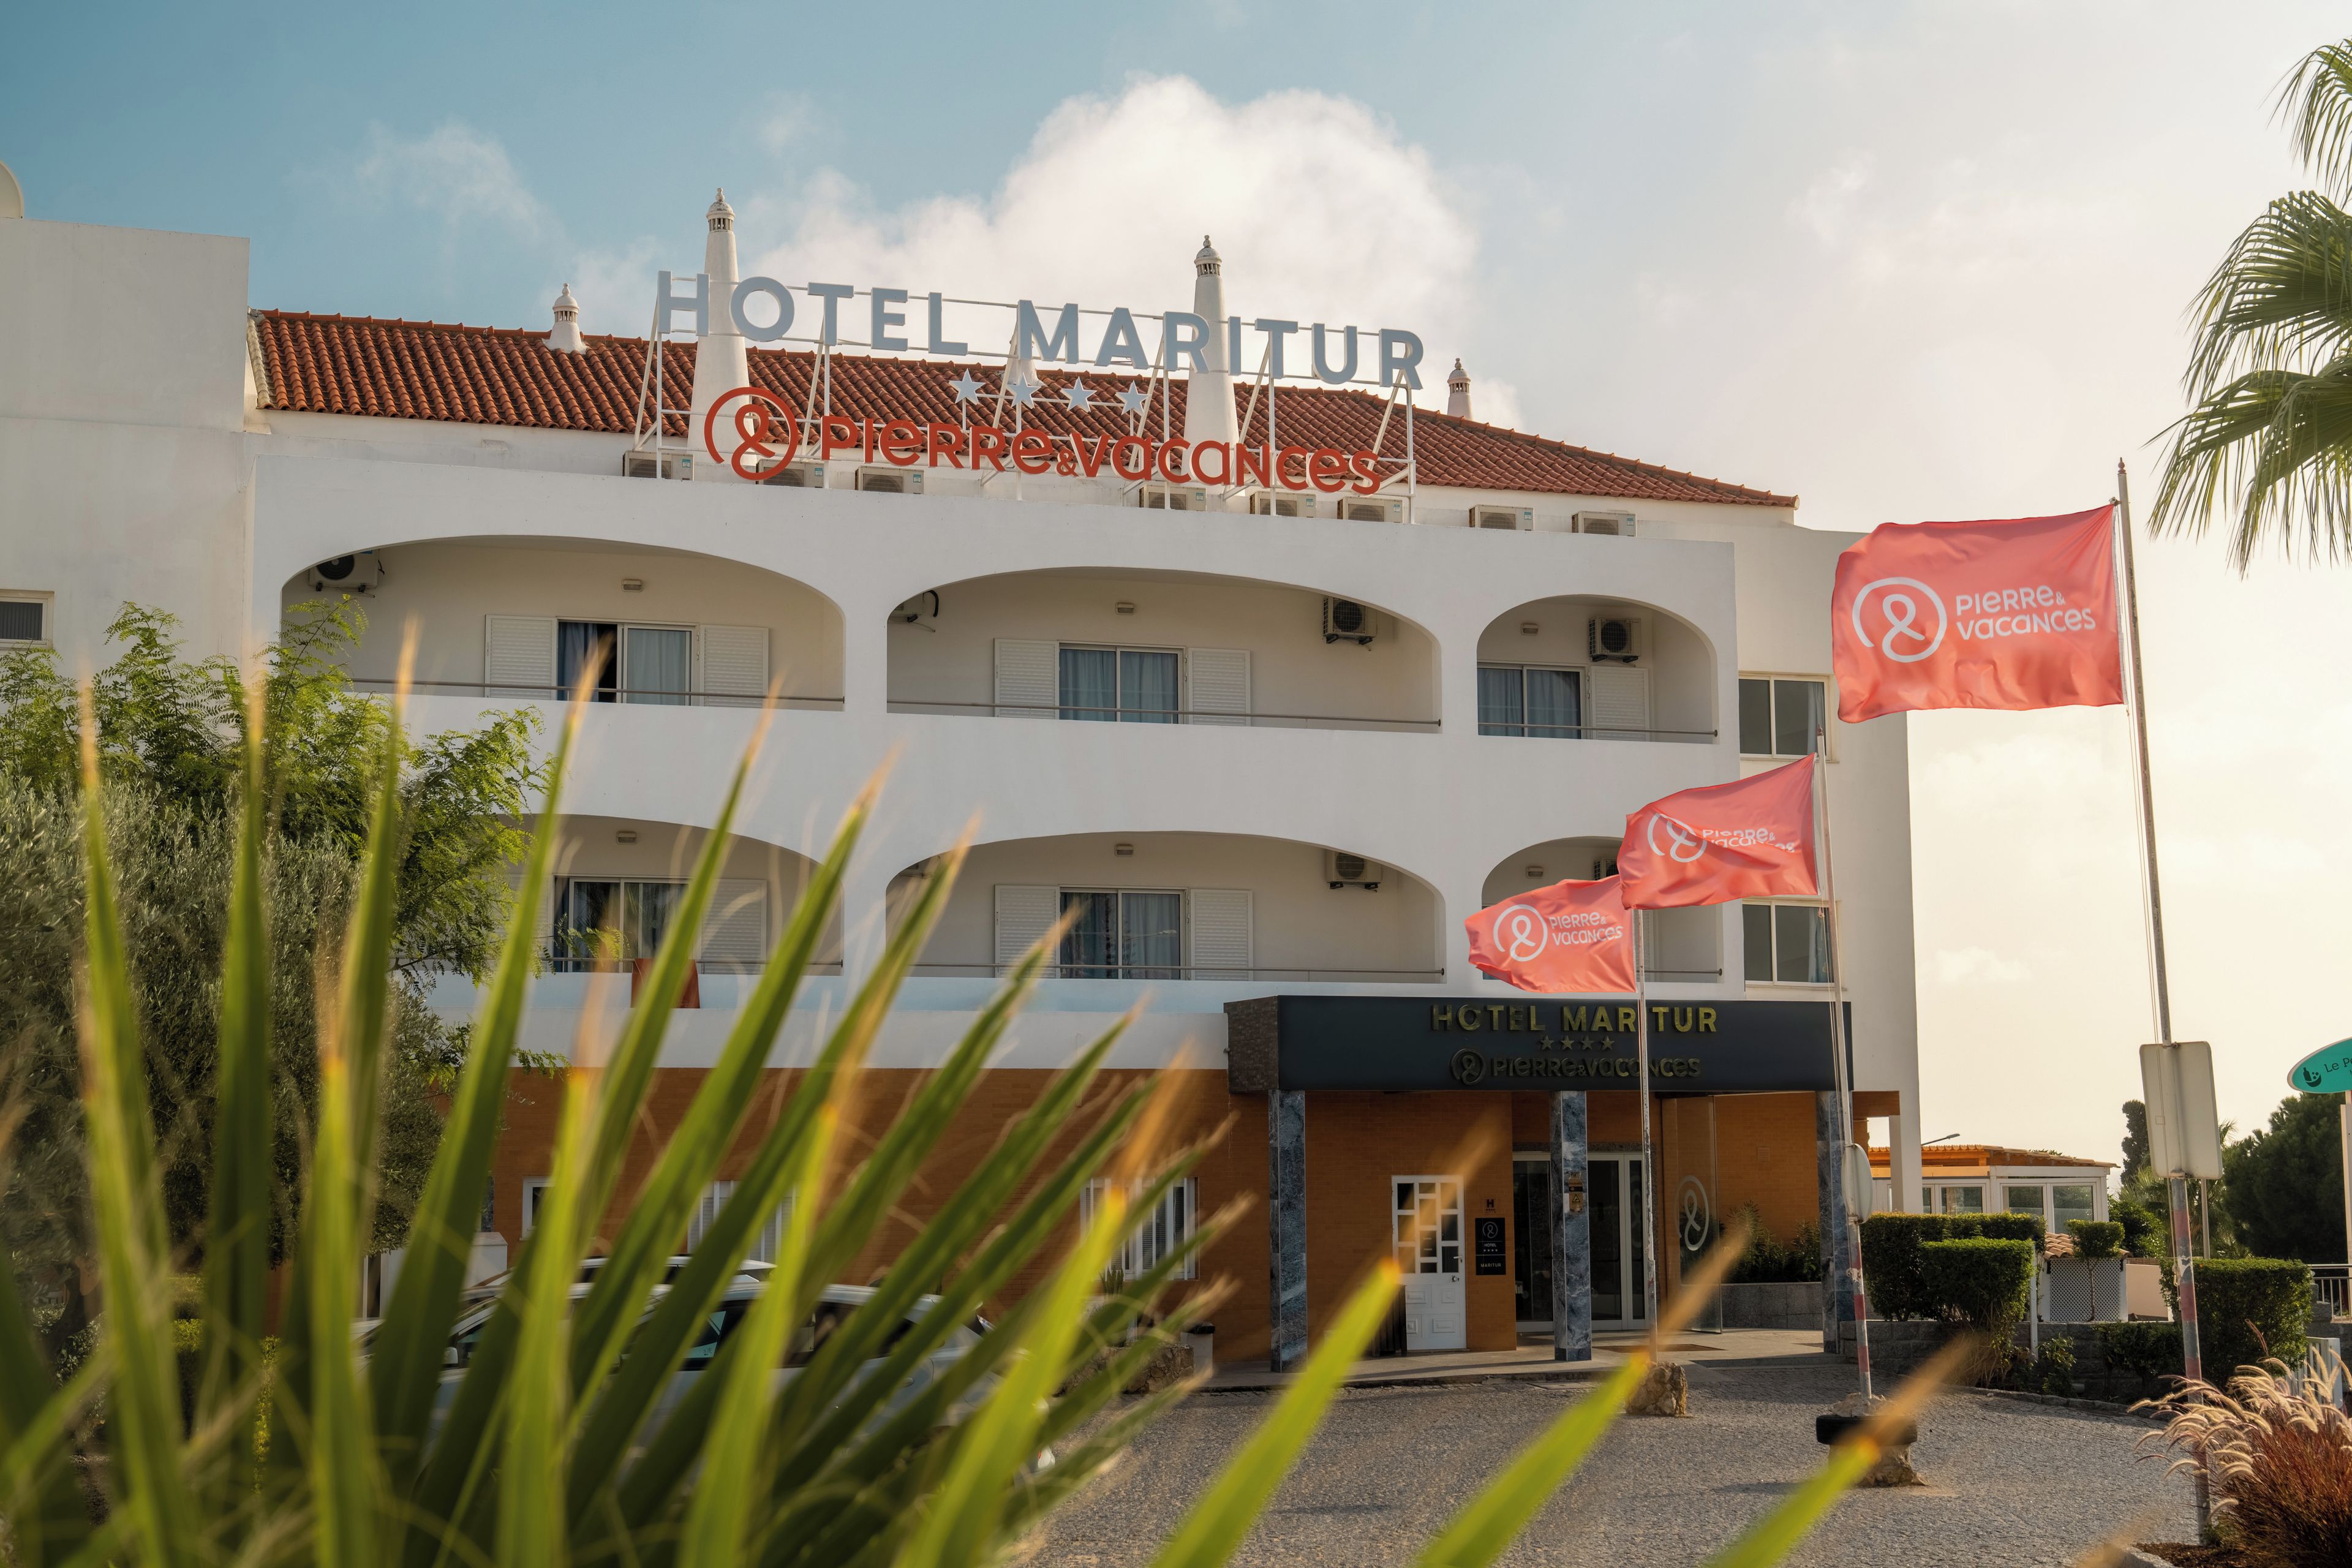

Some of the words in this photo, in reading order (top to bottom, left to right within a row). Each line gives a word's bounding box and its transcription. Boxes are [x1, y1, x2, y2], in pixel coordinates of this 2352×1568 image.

[657, 270, 968, 356] HOTEL
[1017, 299, 1424, 390] MARITUR
[1431, 1004, 1546, 1031] HOTEL
[1562, 1006, 1717, 1033] MARTUR
[2324, 1062, 2340, 1072] Le
[2342, 1057, 2352, 1068] P
[1487, 1199, 1494, 1208] H
